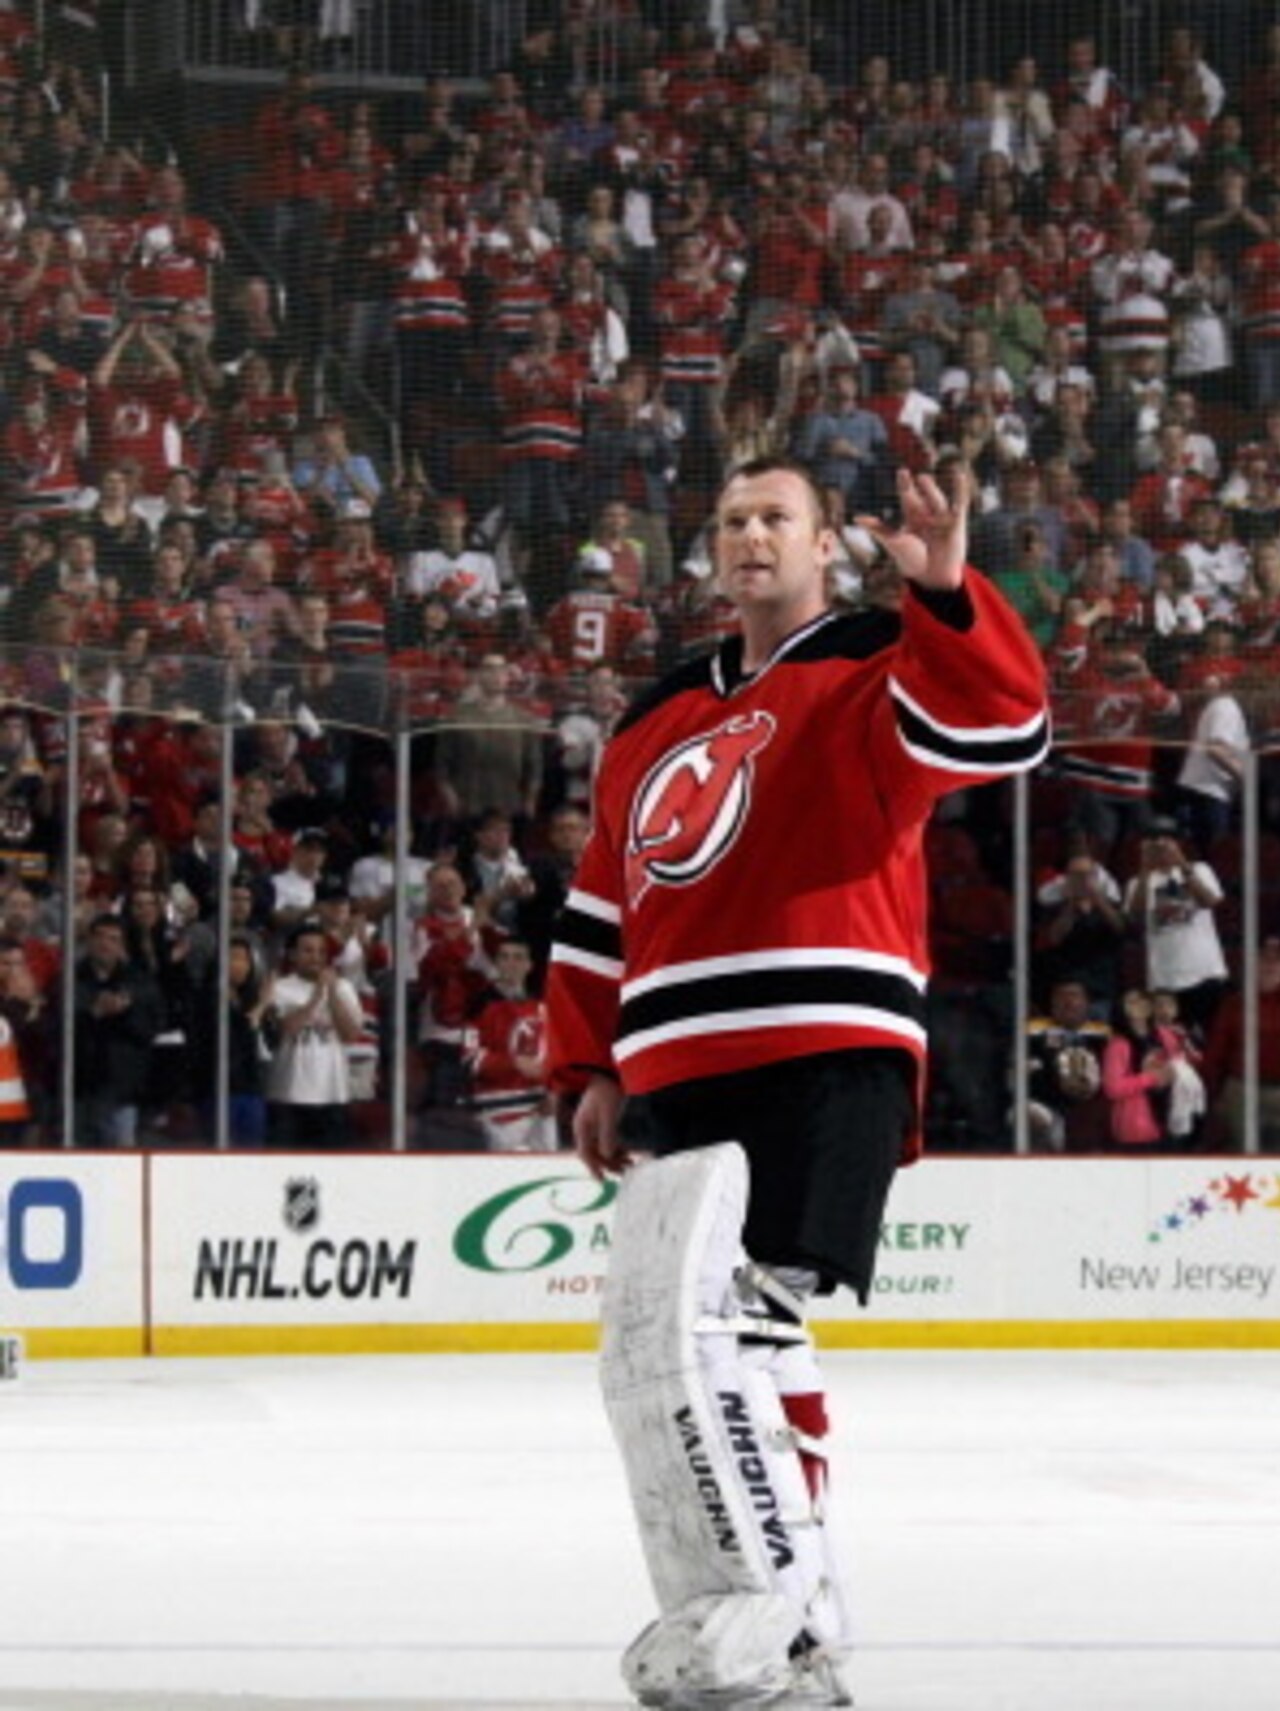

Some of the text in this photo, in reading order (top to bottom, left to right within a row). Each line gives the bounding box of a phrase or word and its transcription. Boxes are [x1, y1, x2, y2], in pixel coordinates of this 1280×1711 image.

[575, 610, 606, 661] 9
[193, 1239, 418, 1301] NHL.COM
[1079, 1257, 1160, 1291] New
[1172, 1257, 1276, 1299] Jersey
[673, 1403, 742, 1553] VAUGHN
[717, 1391, 795, 1573] VAUGHN
